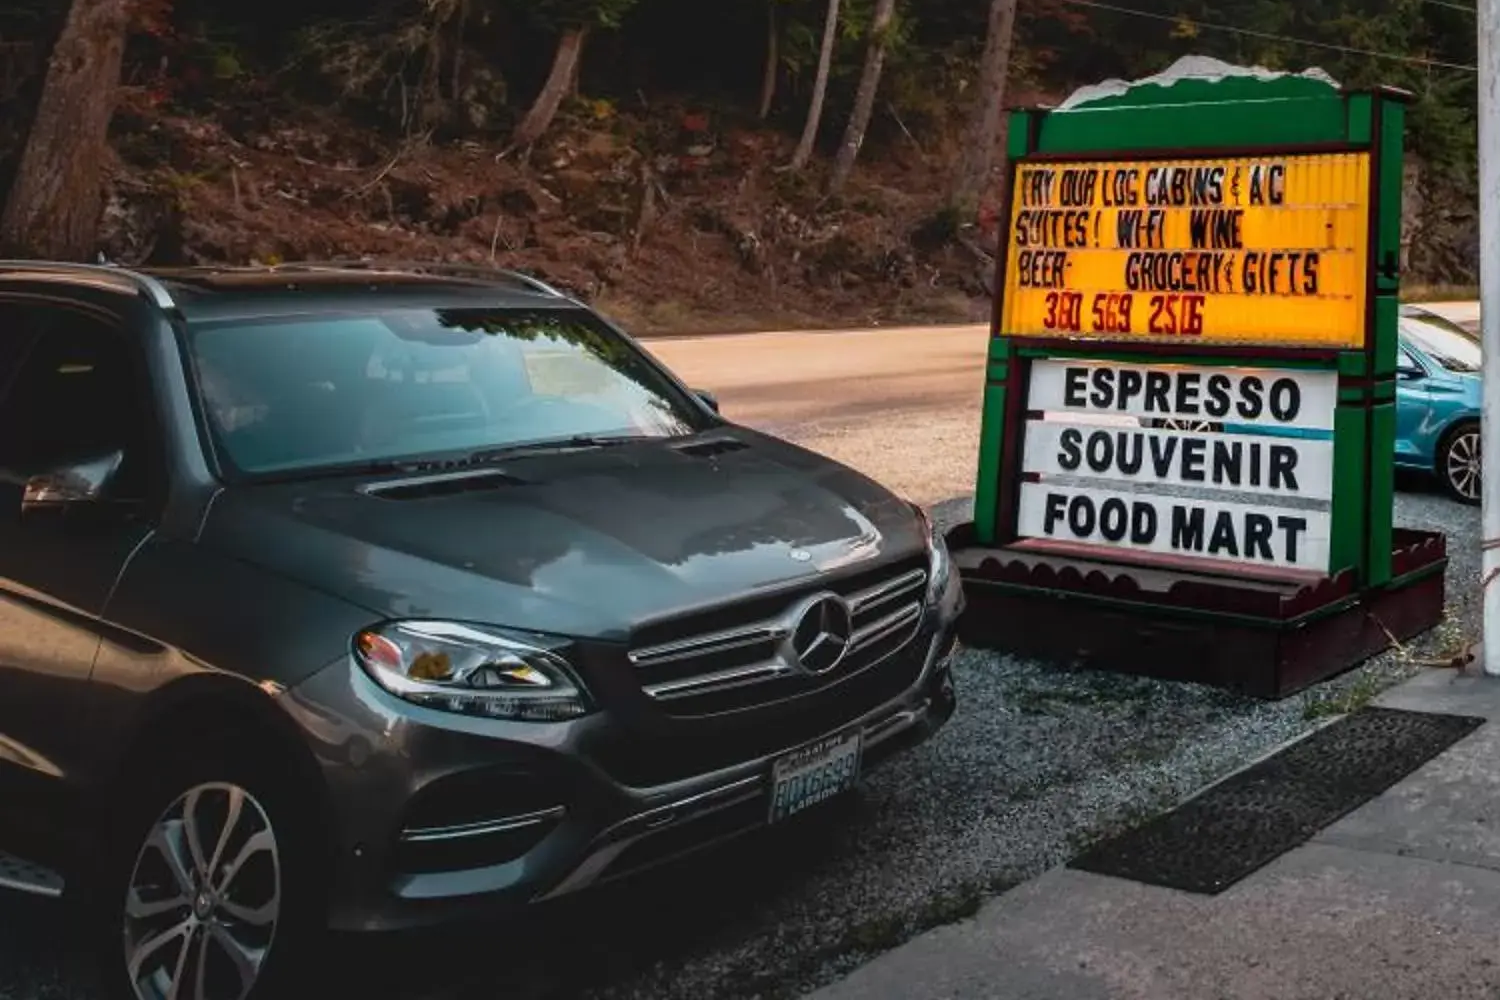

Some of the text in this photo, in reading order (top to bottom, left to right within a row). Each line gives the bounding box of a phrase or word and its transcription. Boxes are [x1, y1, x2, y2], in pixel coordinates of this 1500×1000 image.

[1021, 169, 1054, 206] TRY
[1060, 169, 1098, 206] OUR
[1102, 168, 1139, 206] LOG
[1145, 166, 1224, 206] CABINS
[1117, 210, 1166, 248] WI-FI
[1189, 210, 1243, 248] WINE
[1125, 251, 1221, 292] GROCERY
[1242, 251, 1319, 295] GIFTS
[1091, 293, 1132, 334] 569
[1149, 294, 1205, 335] 2506
[1063, 367, 1301, 423] ESPRESSO
[1057, 428, 1300, 491] SOUVENIR
[1043, 493, 1307, 563] FOOD MART
